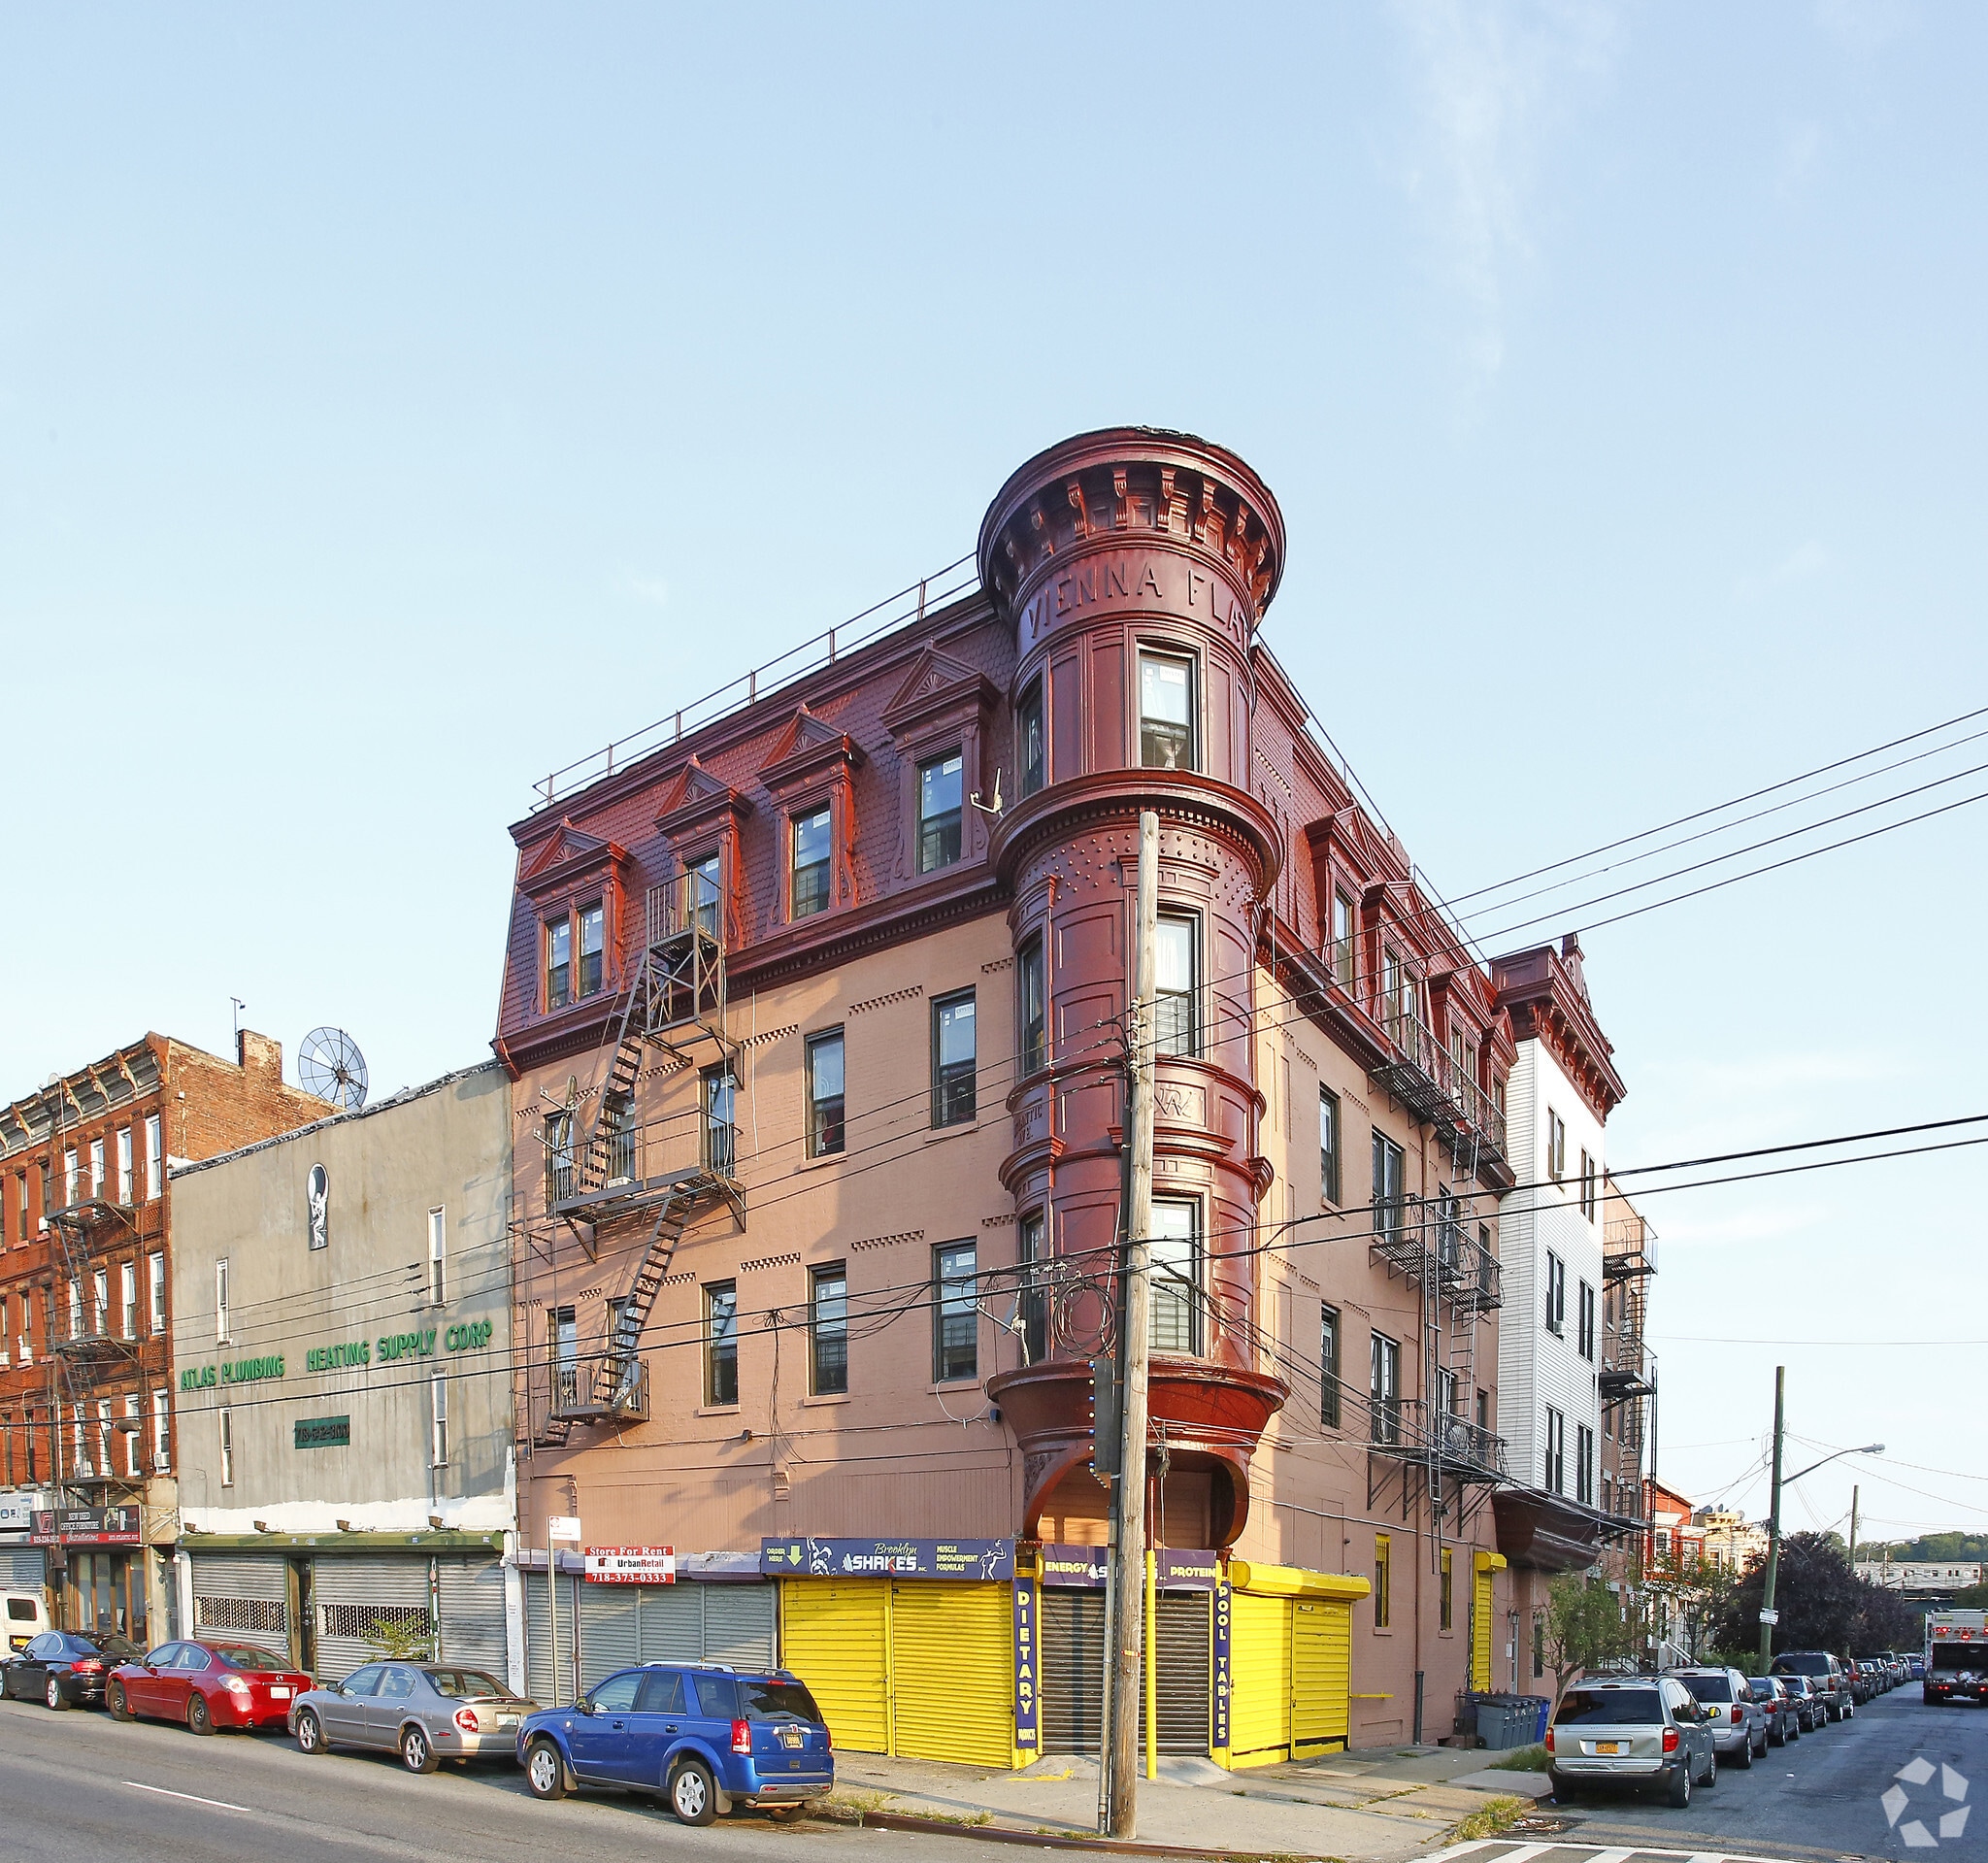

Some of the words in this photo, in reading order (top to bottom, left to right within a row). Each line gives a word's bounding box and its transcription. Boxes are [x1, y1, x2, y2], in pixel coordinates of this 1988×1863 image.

[1028, 561, 1162, 639] VIENNA
[181, 1364, 217, 1390] ATLAS
[221, 1354, 285, 1383] PLUMBING
[307, 1340, 371, 1372] HEATING
[378, 1329, 437, 1362] SUPPLY
[447, 1319, 493, 1351] CORP
[589, 1547, 616, 1556] Store
[619, 1547, 638, 1556] For
[642, 1547, 667, 1556] Rent
[874, 1542, 918, 1560] Brooklyn
[936, 1545, 958, 1553] MUSCLE
[617, 1558, 664, 1568] UrbanRetail
[852, 1555, 917, 1573] SHAKES
[936, 1554, 978, 1563] EMPOWERMENT
[1044, 1561, 1088, 1574] ENERGY
[1170, 1565, 1217, 1579] PROTEIN
[592, 1573, 667, 1582] 718-373-0333
[1217, 1585, 1229, 1641] POOL
[1017, 1590, 1033, 1715] DIETARY
[1217, 1656, 1228, 1740] TABLES
